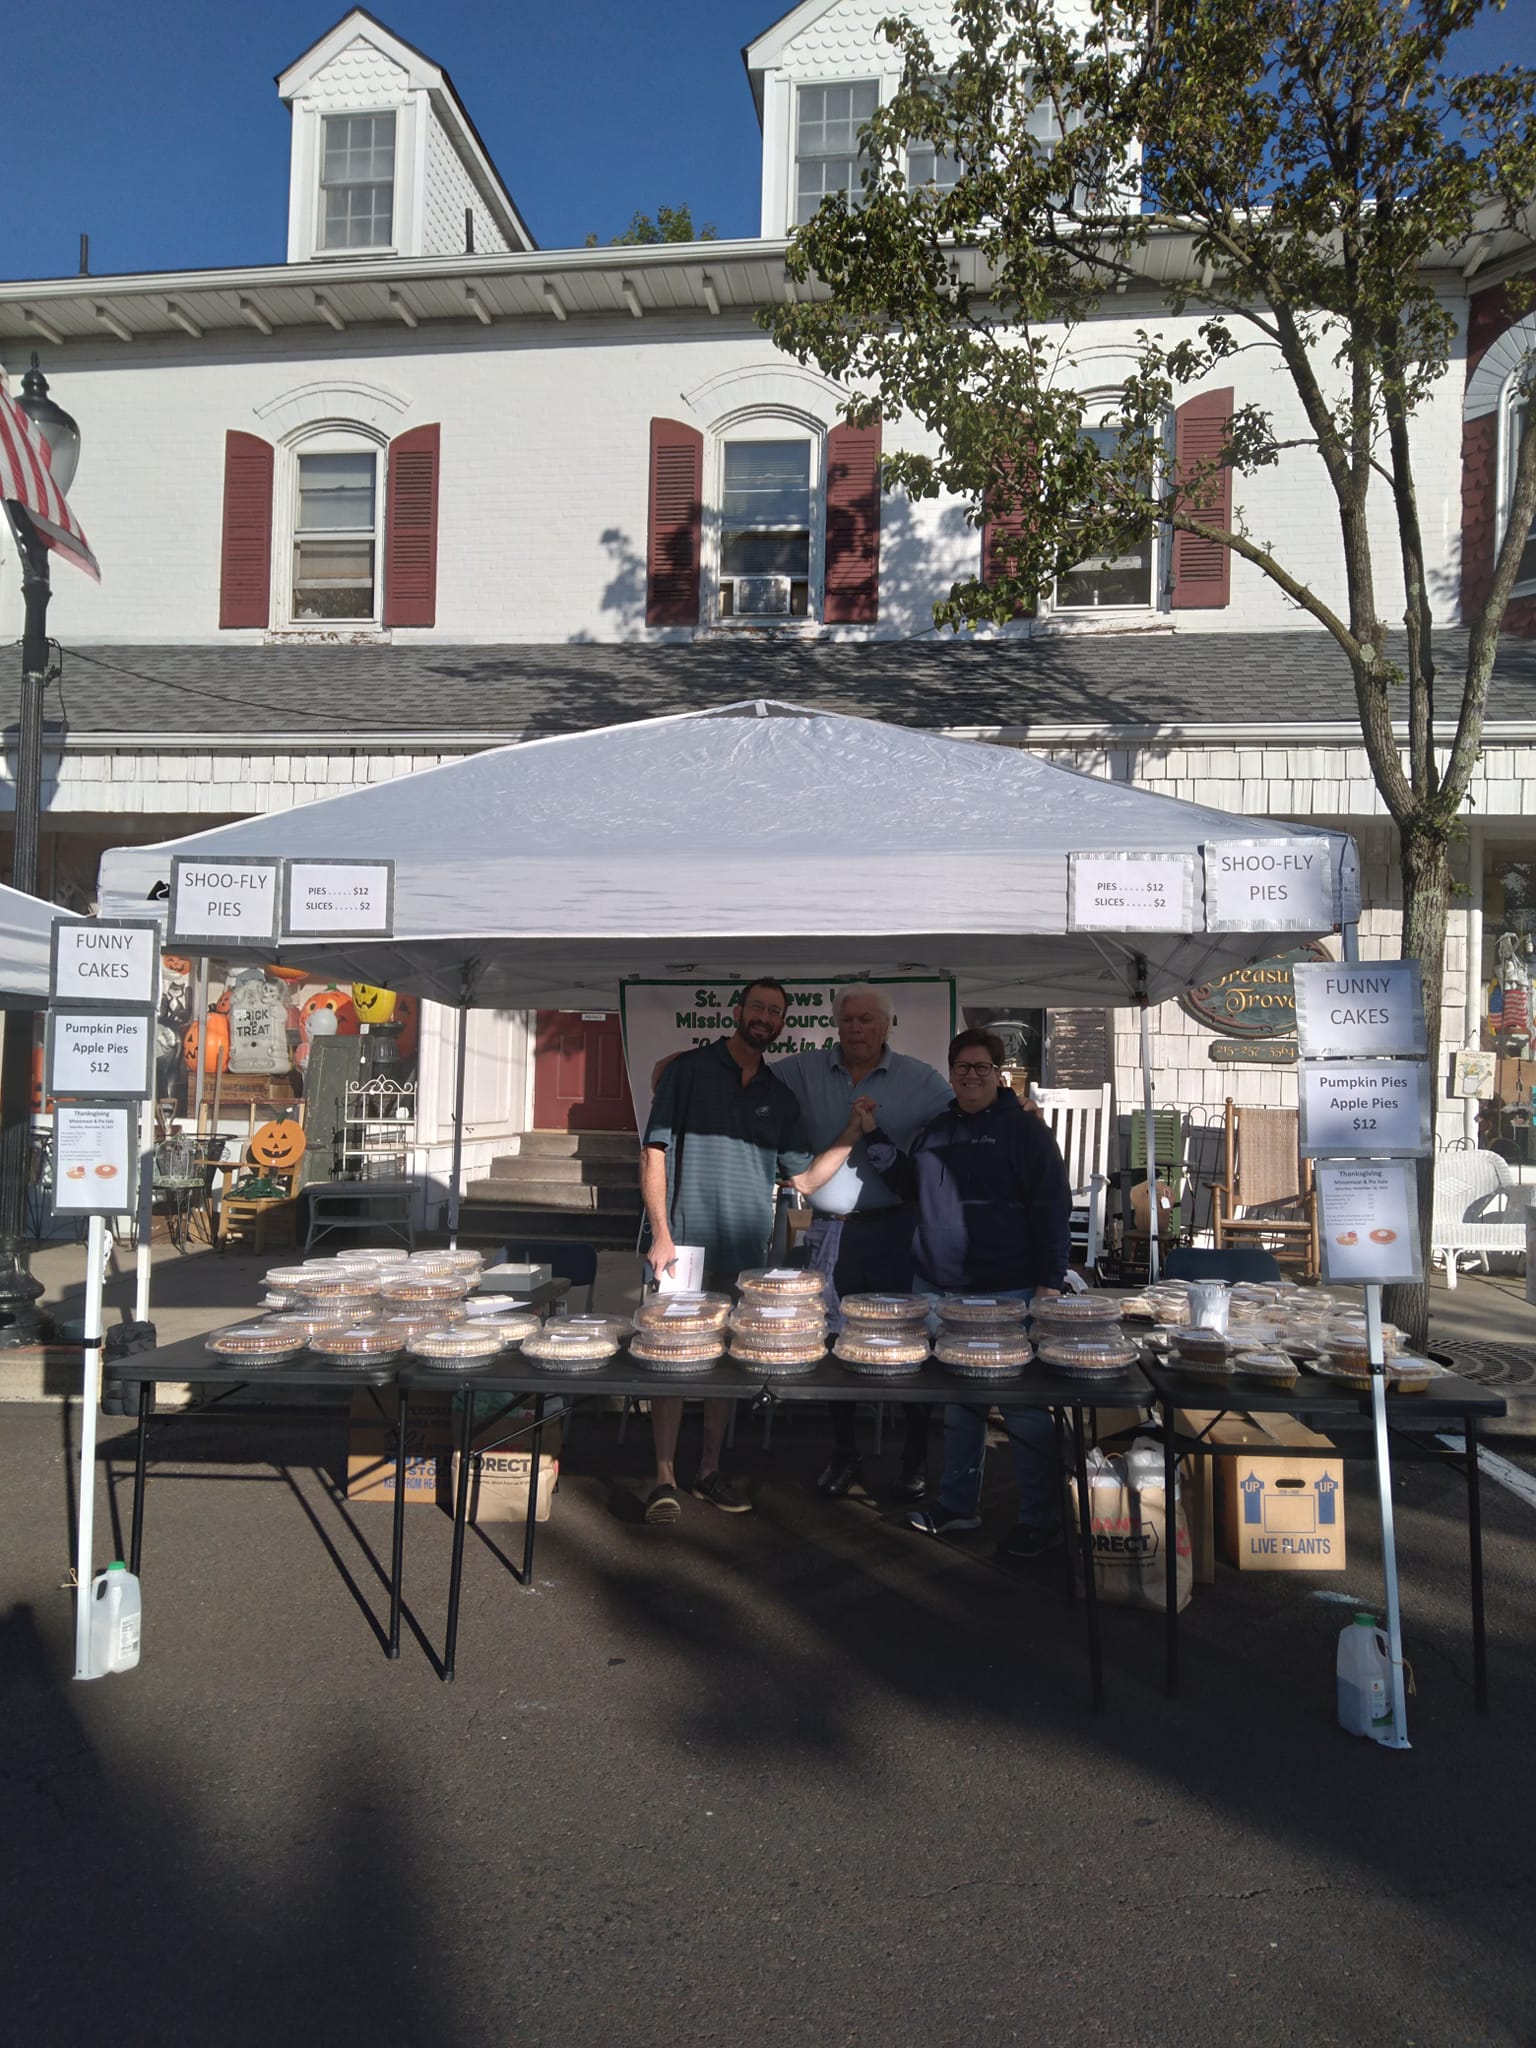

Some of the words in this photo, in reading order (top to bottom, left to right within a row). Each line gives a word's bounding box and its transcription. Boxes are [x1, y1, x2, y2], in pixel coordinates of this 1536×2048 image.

[1221, 855, 1313, 872] SHOO-FLY
[185, 872, 267, 889] SHOO-FLY
[1097, 882, 1117, 891] PIES
[1146, 882, 1164, 892] $12
[308, 887, 326, 895] PIES
[353, 887, 369, 896] $12
[1250, 885, 1288, 901] PIES
[207, 902, 241, 917] PIES
[305, 902, 333, 910] SLICES
[359, 902, 370, 911] $2
[1095, 897, 1125, 907] SLICES
[1154, 898, 1166, 908] $2
[76, 933, 133, 950] FUNNY
[78, 962, 129, 978] CAKES
[1208, 969, 1289, 988] reasu
[1326, 978, 1391, 994] FUNNY
[695, 989, 722, 1008] St.
[238, 1009, 269, 1022] RICK
[676, 1012, 740, 1029] Missio
[1330, 1008, 1389, 1025] CAKES
[65, 1023, 113, 1036] Pumpkin
[116, 1024, 138, 1034] Pies
[236, 1024, 271, 1037] TREAT
[72, 1042, 104, 1055] Apple
[107, 1043, 128, 1054] Pies
[762, 1040, 797, 1054] ork
[90, 1061, 110, 1073] $12
[1320, 1076, 1377, 1090] Pumpkin
[1381, 1076, 1408, 1088] Pies
[1330, 1097, 1368, 1111] Apple
[1372, 1097, 1398, 1109] Pies
[1353, 1118, 1377, 1131] $12
[1339, 1170, 1382, 1178] Thanksgiving
[1245, 1481, 1260, 1493] UP
[1319, 1481, 1335, 1493] UP
[1251, 1538, 1277, 1554] LIVE
[1282, 1538, 1331, 1554] PLANTS
